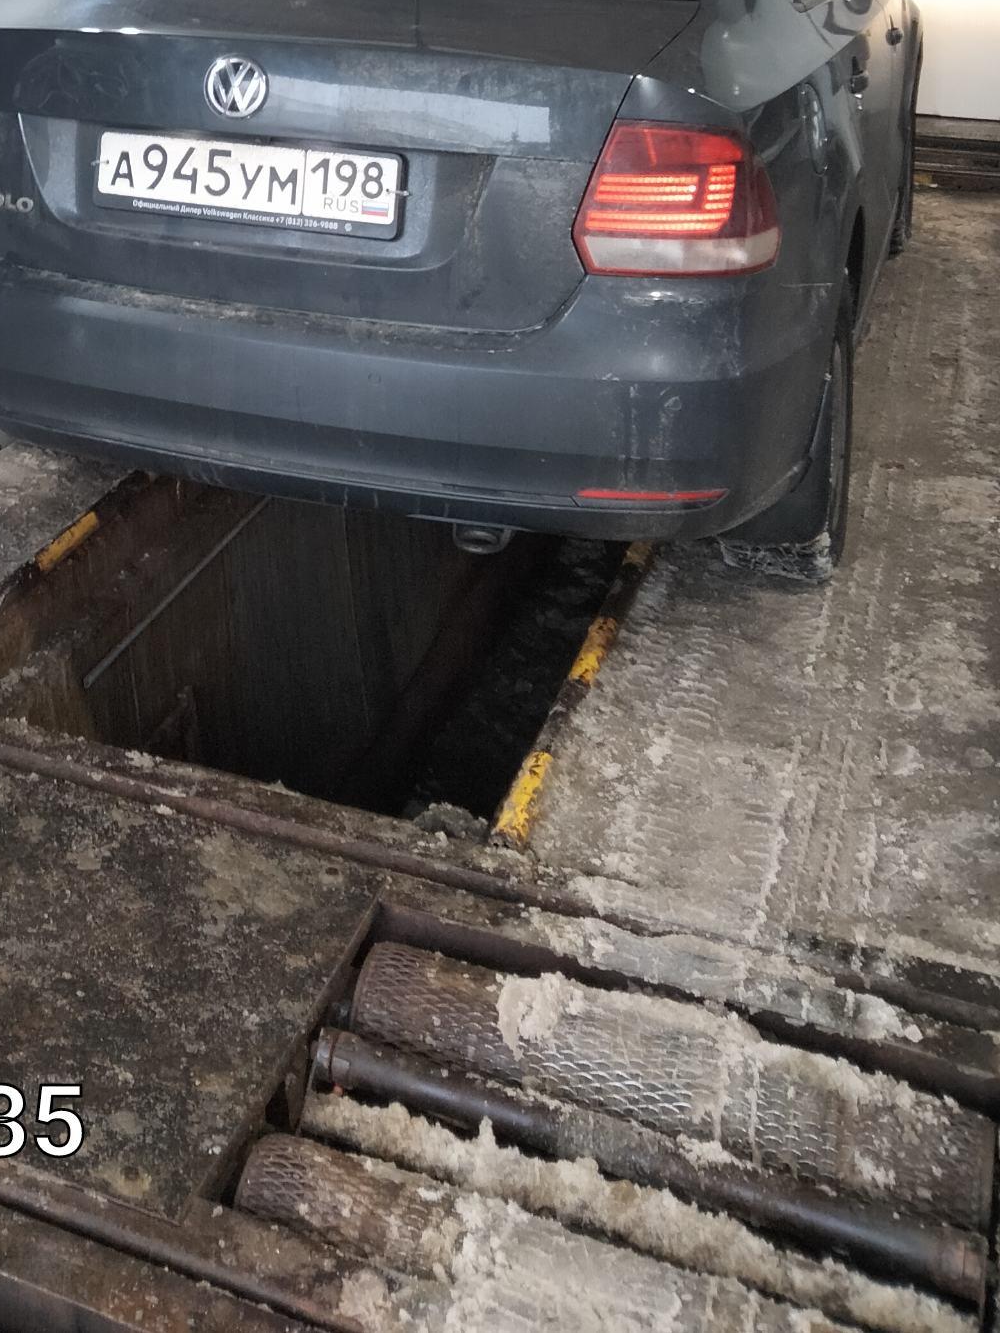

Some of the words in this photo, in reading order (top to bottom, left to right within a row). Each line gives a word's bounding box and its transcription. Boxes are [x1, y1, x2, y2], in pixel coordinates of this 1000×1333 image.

[310, 158, 384, 199] 198
[323, 197, 360, 213] RUS
[203, 208, 242, 219] Volkswagen
